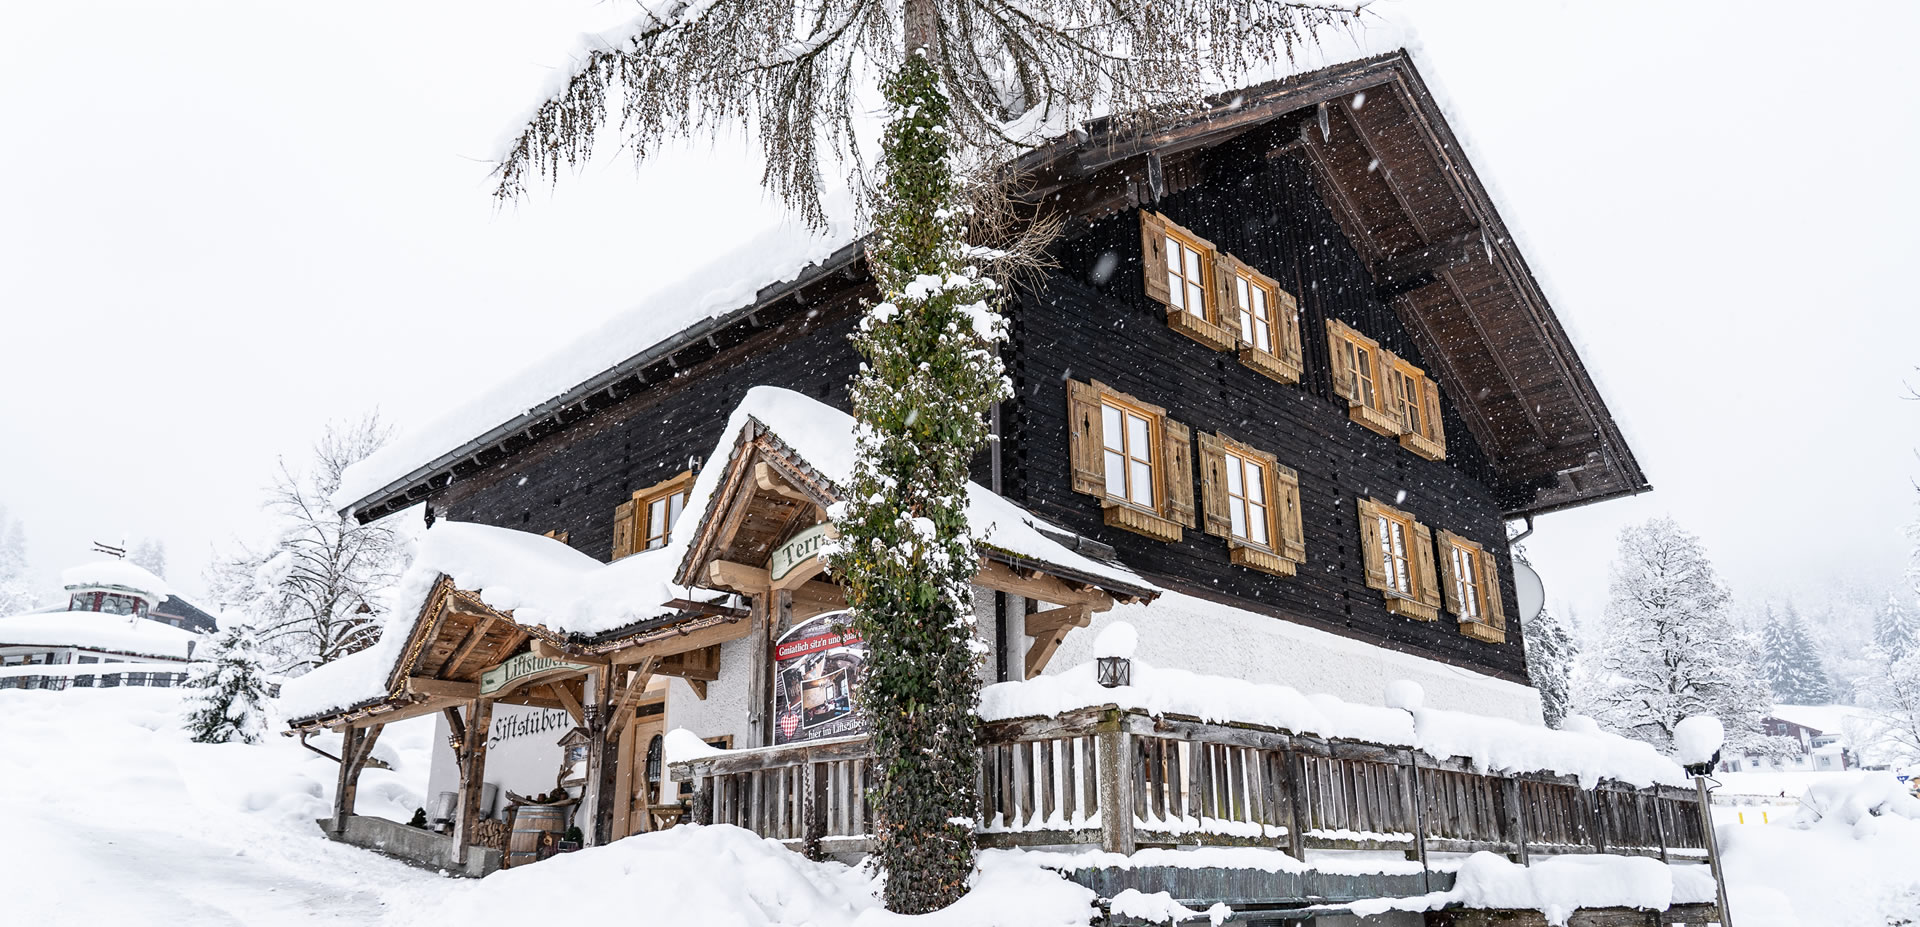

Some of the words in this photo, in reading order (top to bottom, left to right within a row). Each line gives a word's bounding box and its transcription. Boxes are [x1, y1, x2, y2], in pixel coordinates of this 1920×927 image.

[782, 533, 824, 567] Terr
[779, 641, 809, 656] Gmiatlich
[489, 708, 569, 750] Liftstüberl
[808, 728, 821, 740] hier
[822, 728, 832, 736] im
[833, 719, 867, 733] Liftsübrl
